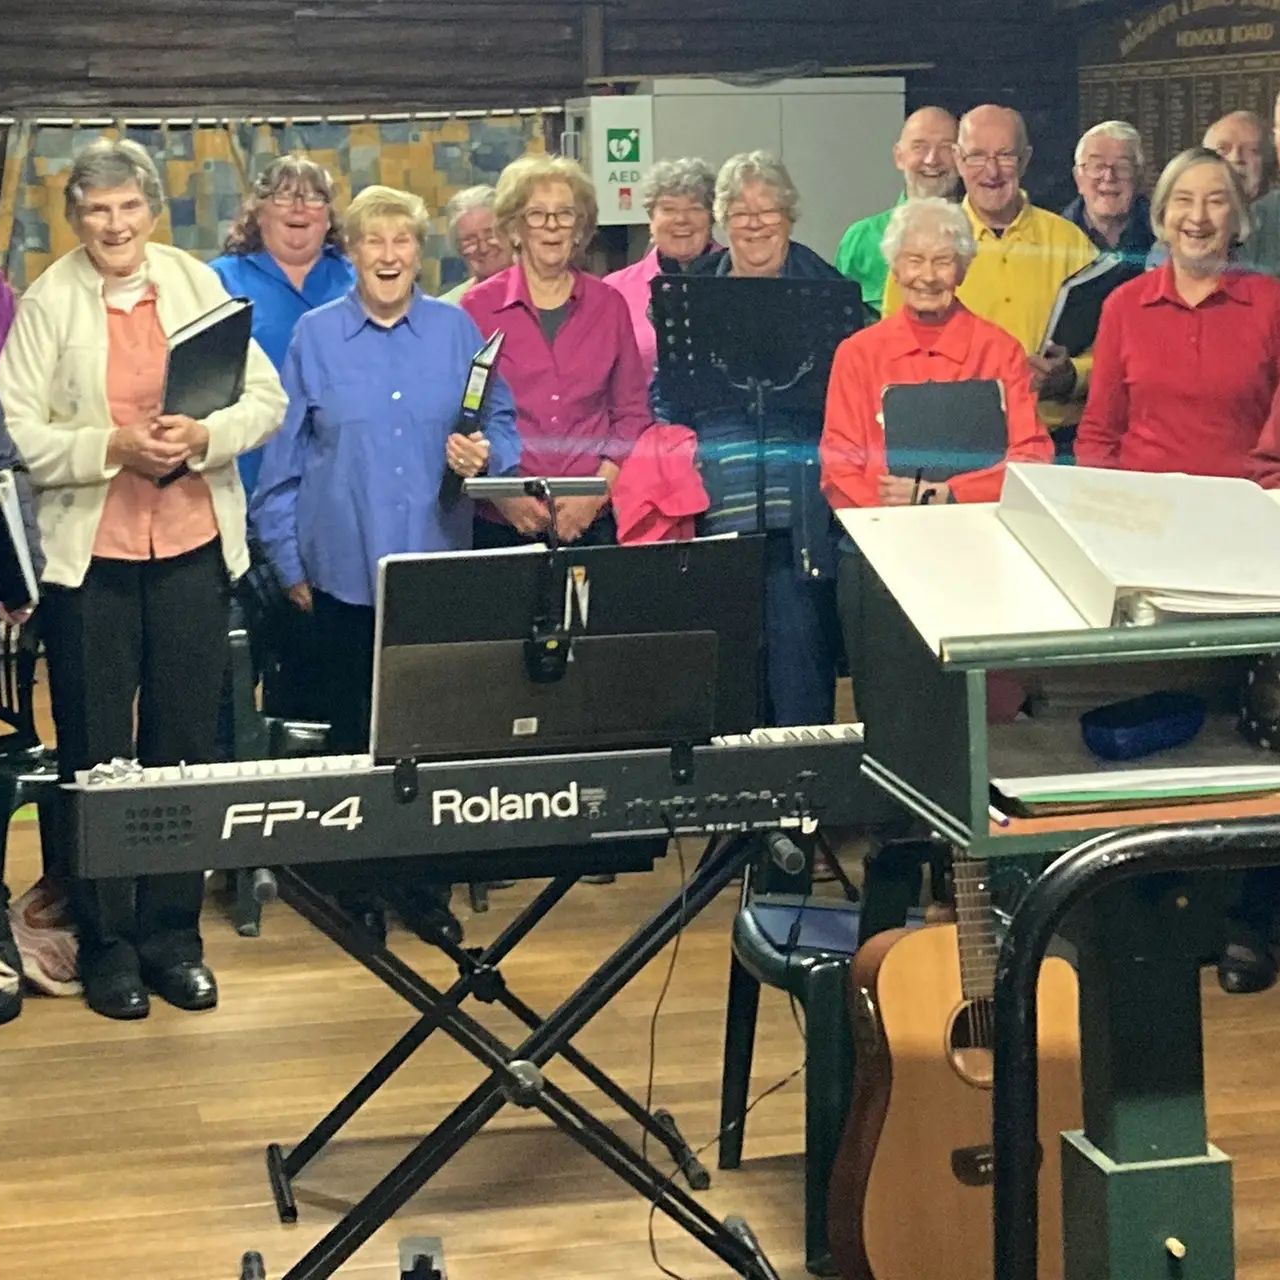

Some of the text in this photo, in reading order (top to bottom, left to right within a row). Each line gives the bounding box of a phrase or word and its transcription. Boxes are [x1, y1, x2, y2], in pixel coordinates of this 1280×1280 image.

[1231, 23, 1275, 43] BOARD
[608, 170, 641, 183] AED
[221, 796, 363, 839] FP-4
[432, 781, 579, 826] Roland
